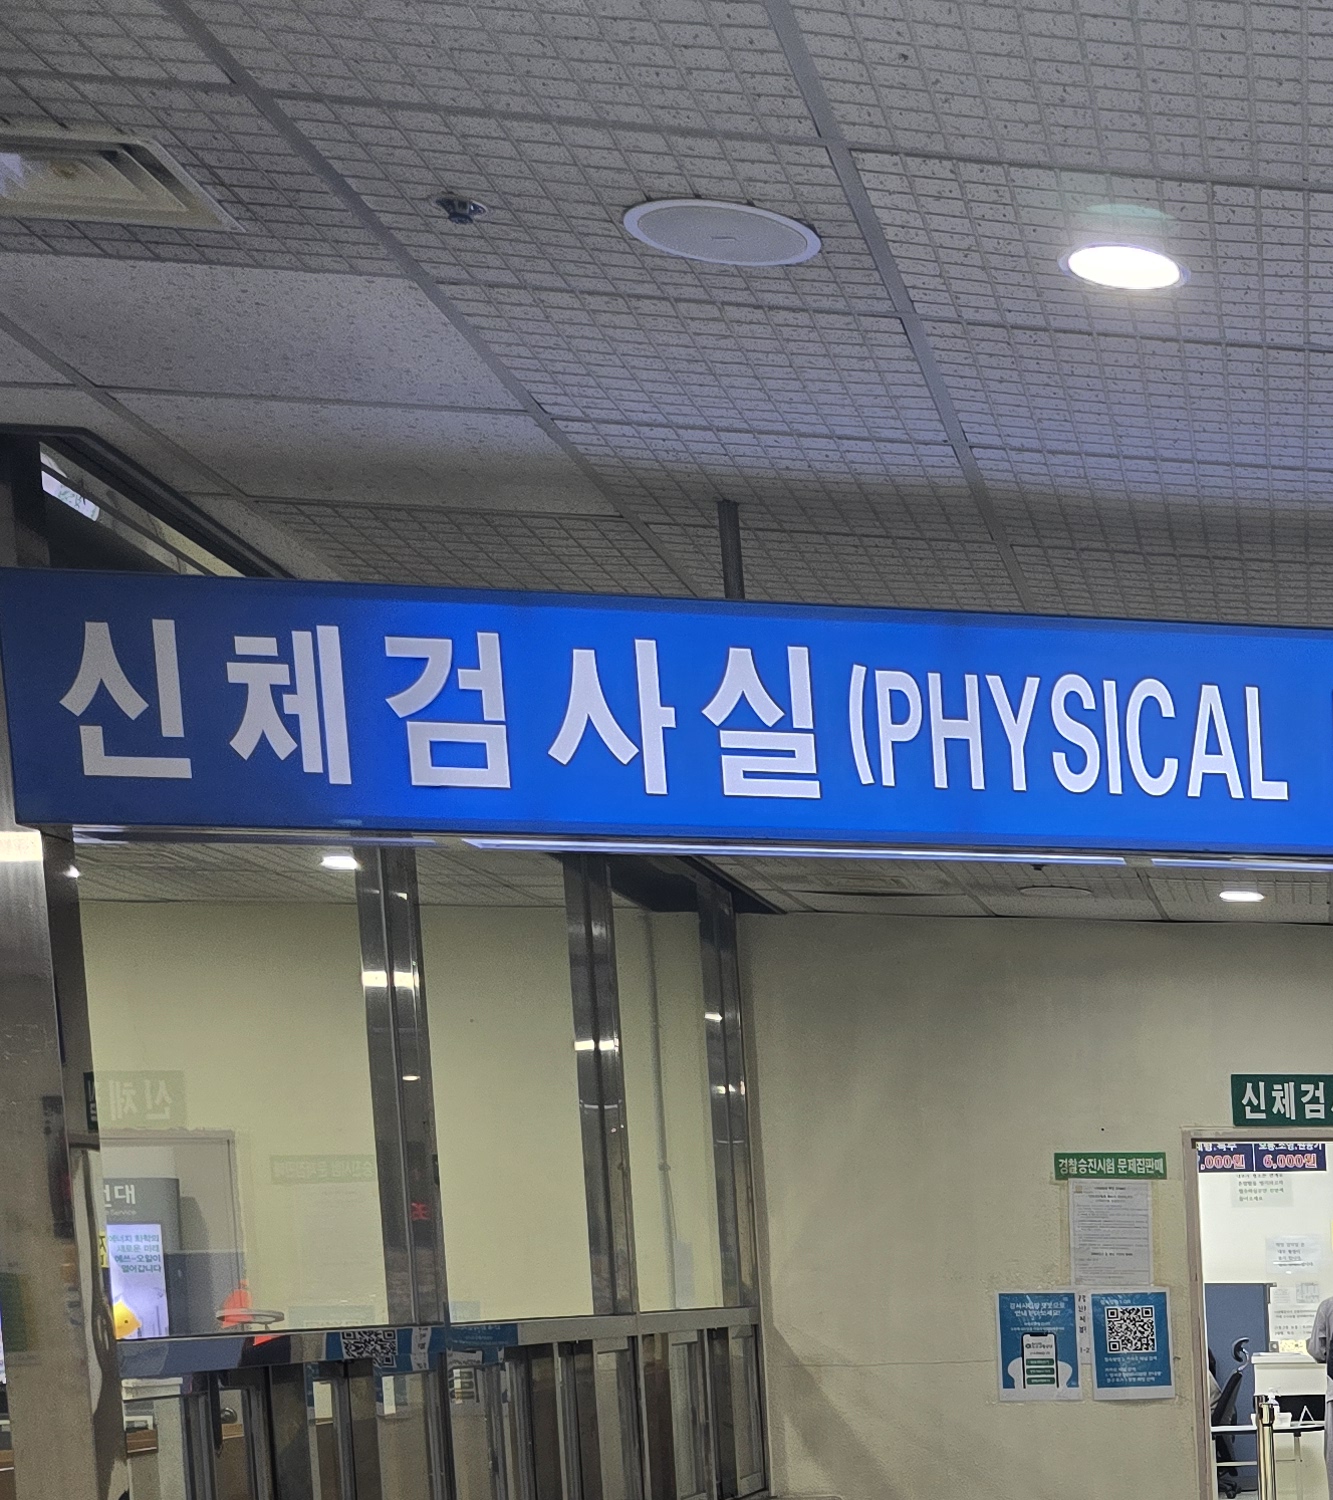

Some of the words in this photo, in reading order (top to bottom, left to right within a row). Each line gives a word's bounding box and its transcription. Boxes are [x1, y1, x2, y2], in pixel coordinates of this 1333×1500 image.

[60, 618, 822, 799] 신체검사실
[848, 664, 1288, 802] (PHYSICAL
[1059, 1158, 1115, 1174] 경찰승진시험
[1117, 1158, 1164, 1174] 문제집판매
[1198, 1154, 1245, 1170] ,000원
[1263, 1154, 1317, 1169] 6,000원
